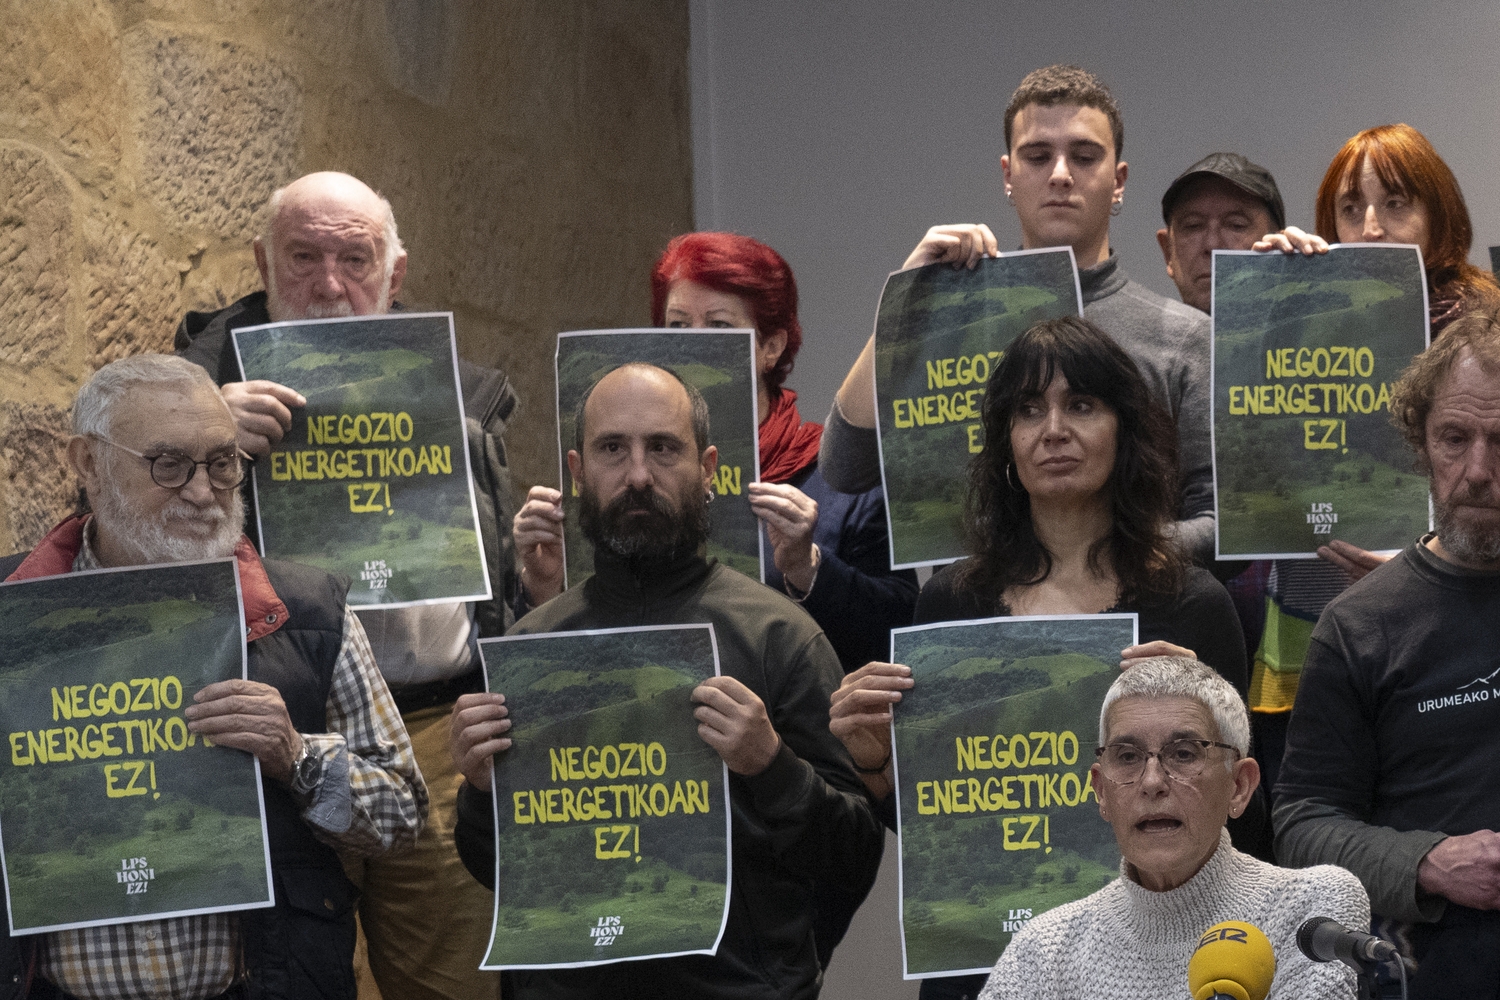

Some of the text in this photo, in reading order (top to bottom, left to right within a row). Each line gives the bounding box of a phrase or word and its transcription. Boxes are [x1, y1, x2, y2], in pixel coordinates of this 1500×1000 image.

[1266, 346, 1374, 379] NEGOZIO
[893, 386, 986, 428] ENERGE
[307, 412, 414, 444] NEGOZIO
[1304, 419, 1348, 455] EZ!
[271, 445, 452, 480] ENERGETIKOARI
[348, 483, 394, 515] EZ!
[1311, 502, 1333, 513] LPS
[1306, 513, 1338, 524] HONI
[1313, 524, 1332, 534] EZ!
[361, 568, 392, 580] HONI
[365, 560, 386, 570] LPS
[370, 579, 387, 589] EZ!
[51, 676, 183, 722] NEGOZIO
[1418, 690, 1489, 713] URUMEAKO
[549, 742, 667, 784] NEGOZIO
[956, 731, 1079, 772] NEGOZIO
[104, 762, 160, 800] EZ!
[513, 780, 710, 825] ENERGETIKOARI
[594, 824, 643, 862] EZ!
[1002, 815, 1052, 854] EZ!
[121, 856, 148, 870] LPS
[116, 868, 155, 883] HONI
[126, 881, 148, 895] EZ!
[597, 915, 621, 927] LPS
[1008, 908, 1033, 920] LPS
[590, 925, 625, 937] HONI
[1003, 920, 1029, 932] HO
[594, 936, 616, 946] EZ!
[1194, 928, 1248, 954] ER
